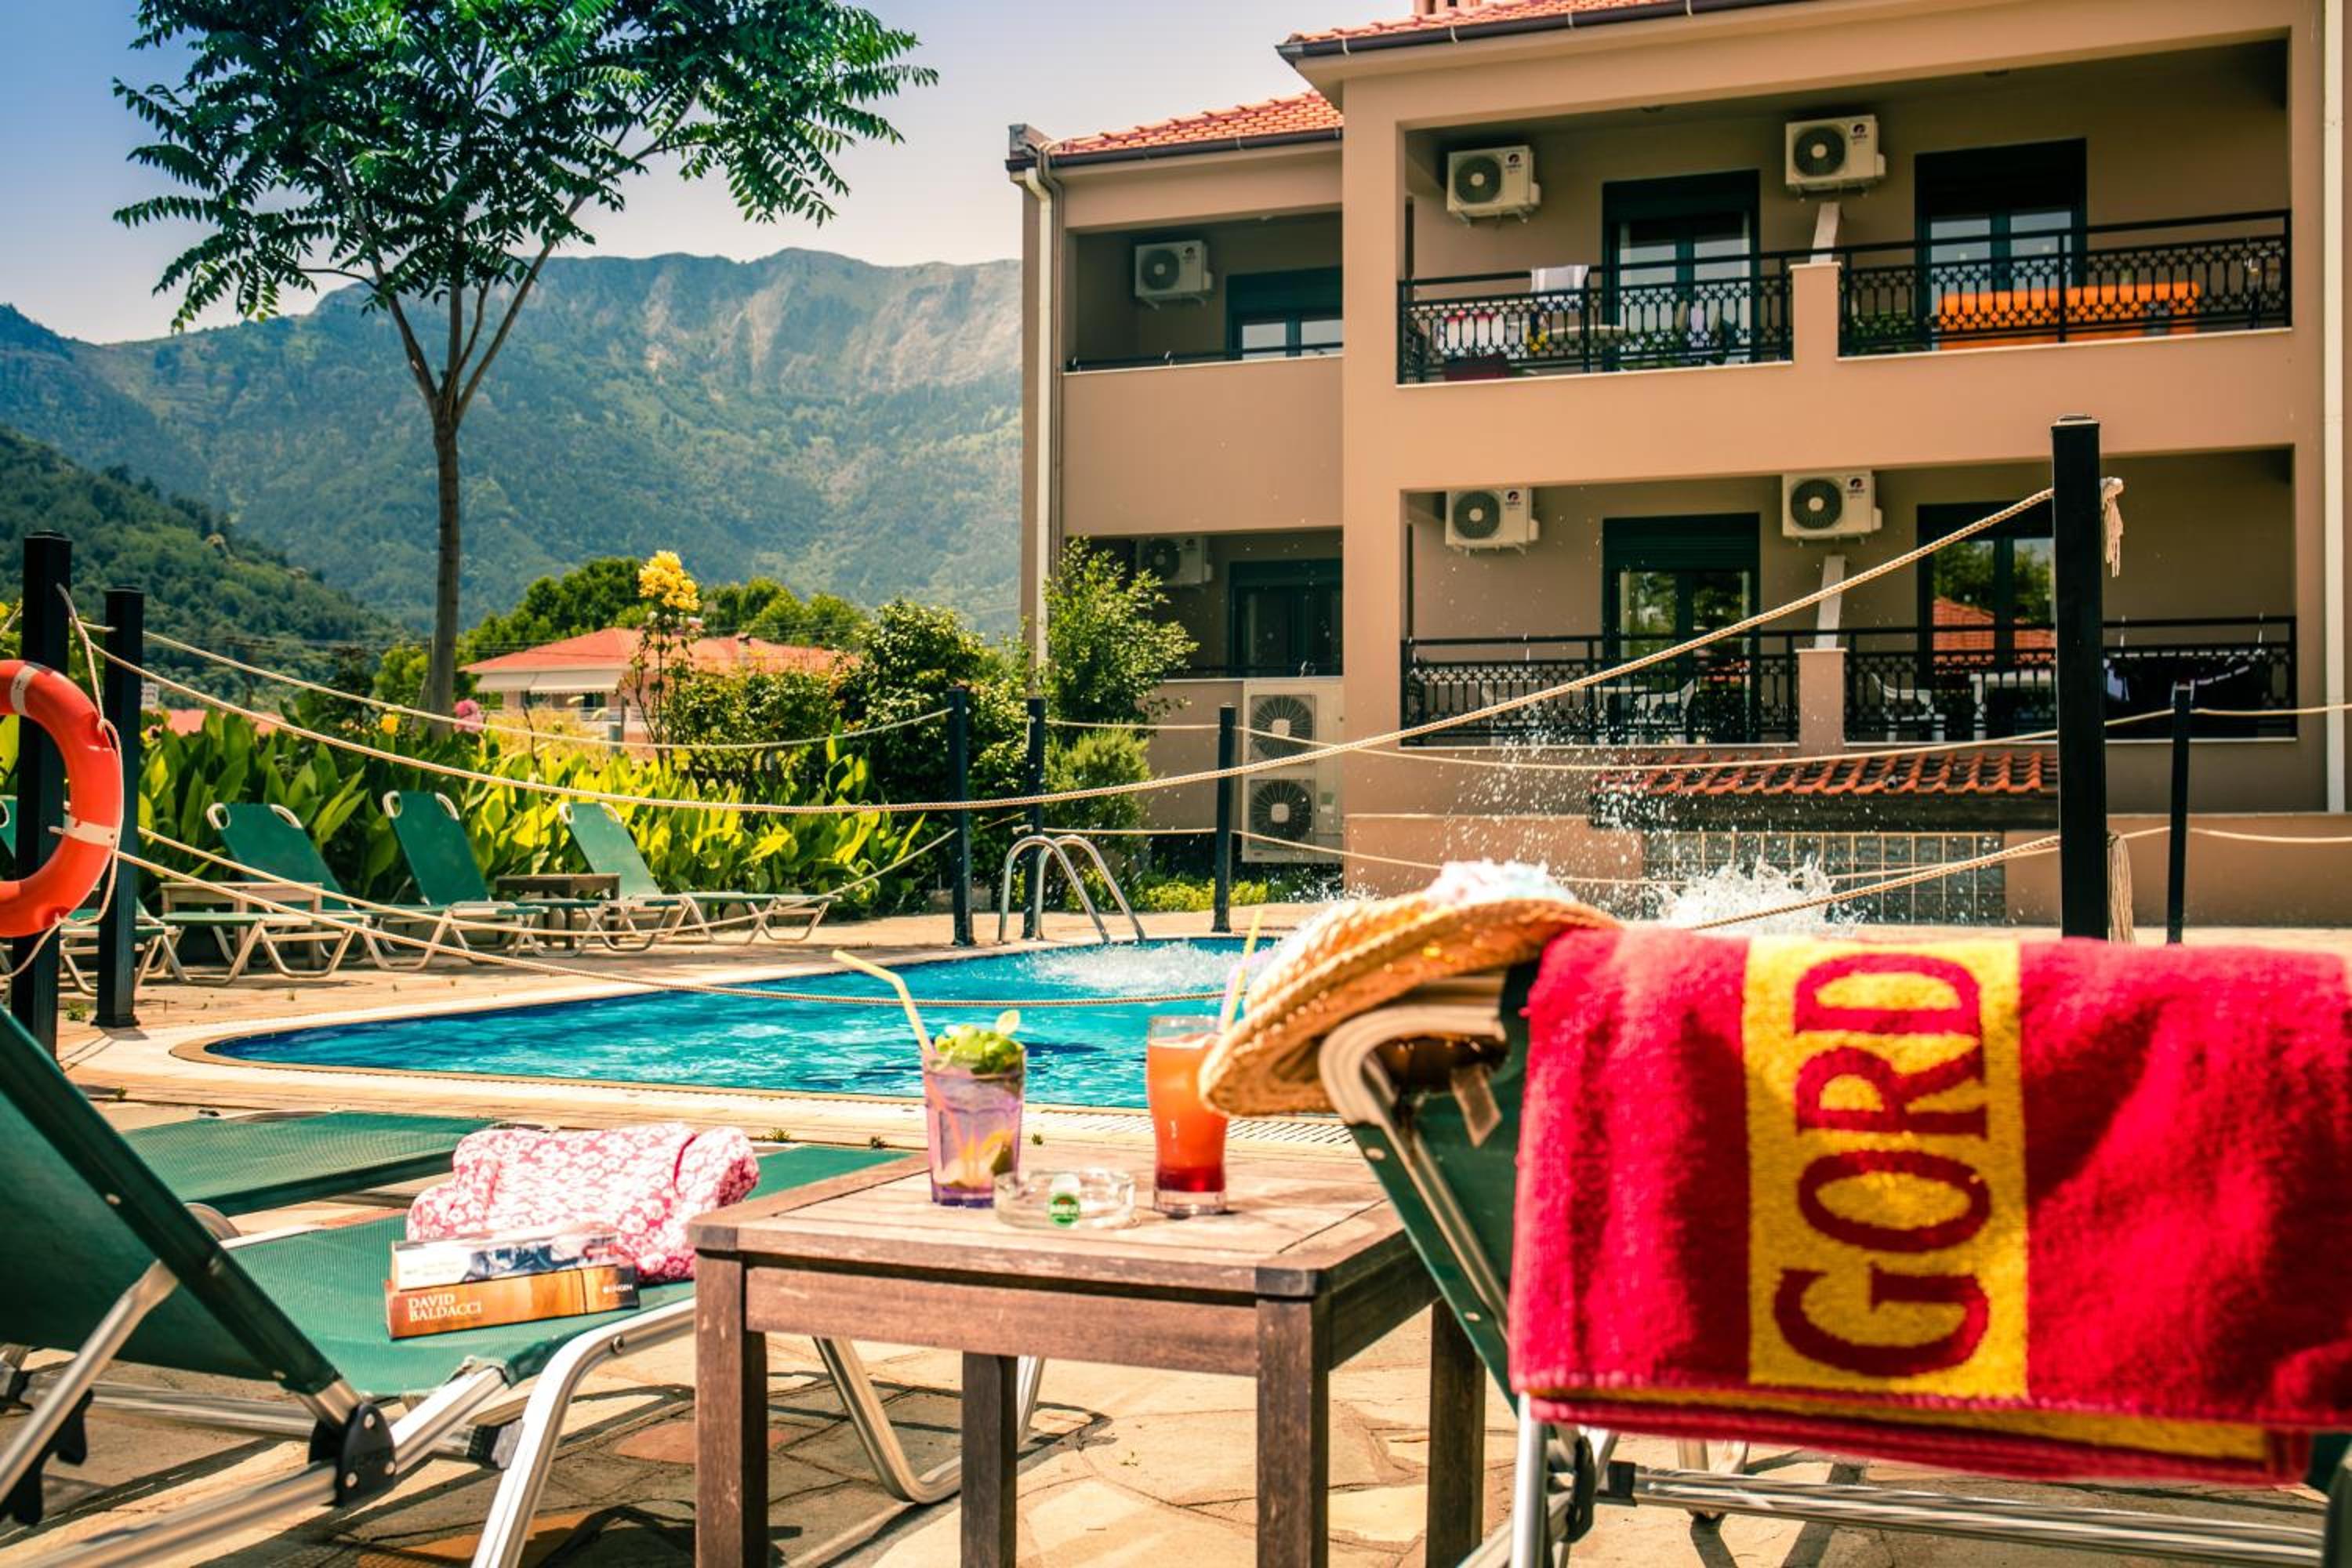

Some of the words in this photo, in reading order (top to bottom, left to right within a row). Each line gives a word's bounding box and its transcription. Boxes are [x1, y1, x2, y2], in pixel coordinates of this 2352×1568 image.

[1774, 953, 1991, 1377] GORD
[408, 1294, 455, 1308] DAVID
[409, 1301, 482, 1323] BALDACCI
